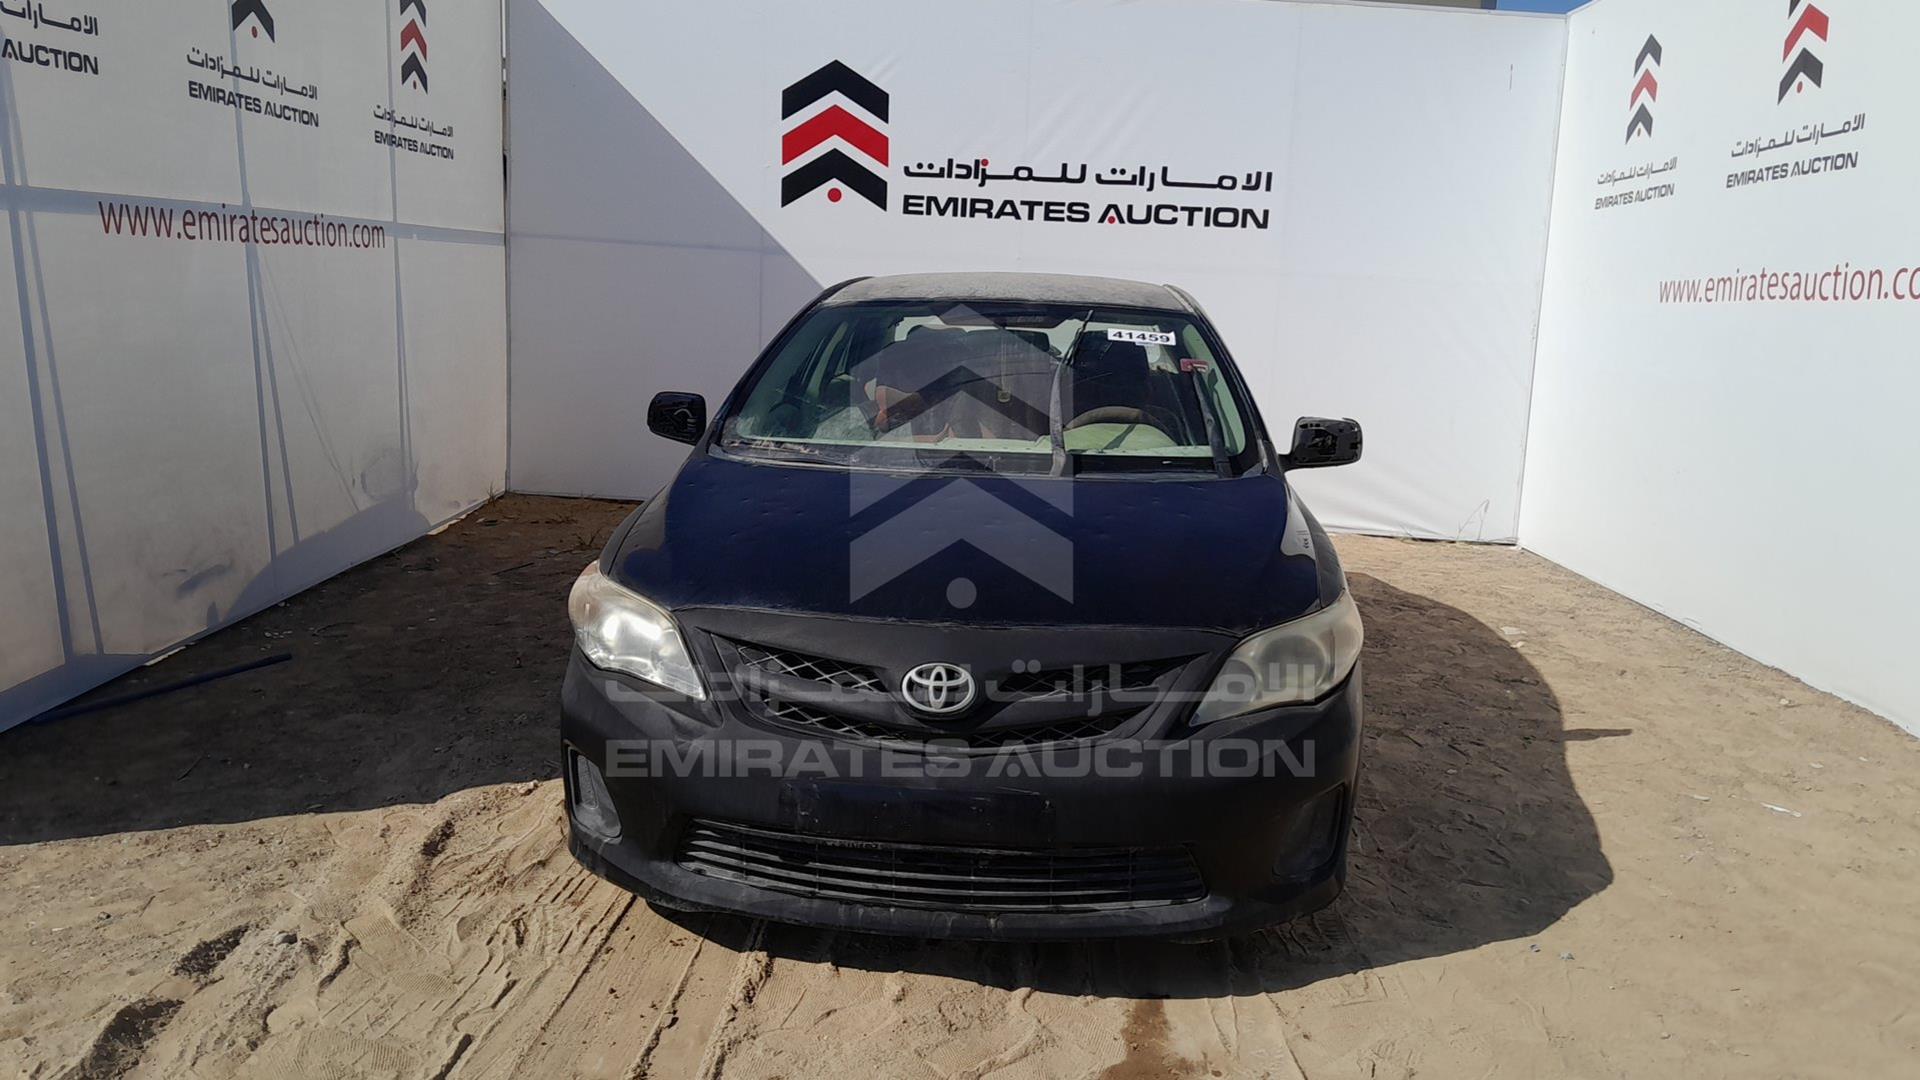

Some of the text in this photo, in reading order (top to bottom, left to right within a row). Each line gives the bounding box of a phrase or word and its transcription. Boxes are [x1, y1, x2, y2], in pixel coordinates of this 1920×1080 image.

[2, 38, 99, 75] AUCTION
[188, 80, 319, 128] EMIRATES AUCTION
[374, 130, 454, 160] EMIRATES AUCTION
[1726, 151, 1859, 189] EMIRATES AUCTION
[902, 194, 1270, 229] EMIRATES AUCTION
[1594, 182, 1675, 210] EMIRATES AUCTION
[98, 201, 386, 249] www.emiratesauction.com
[1112, 331, 1170, 343] 41459
